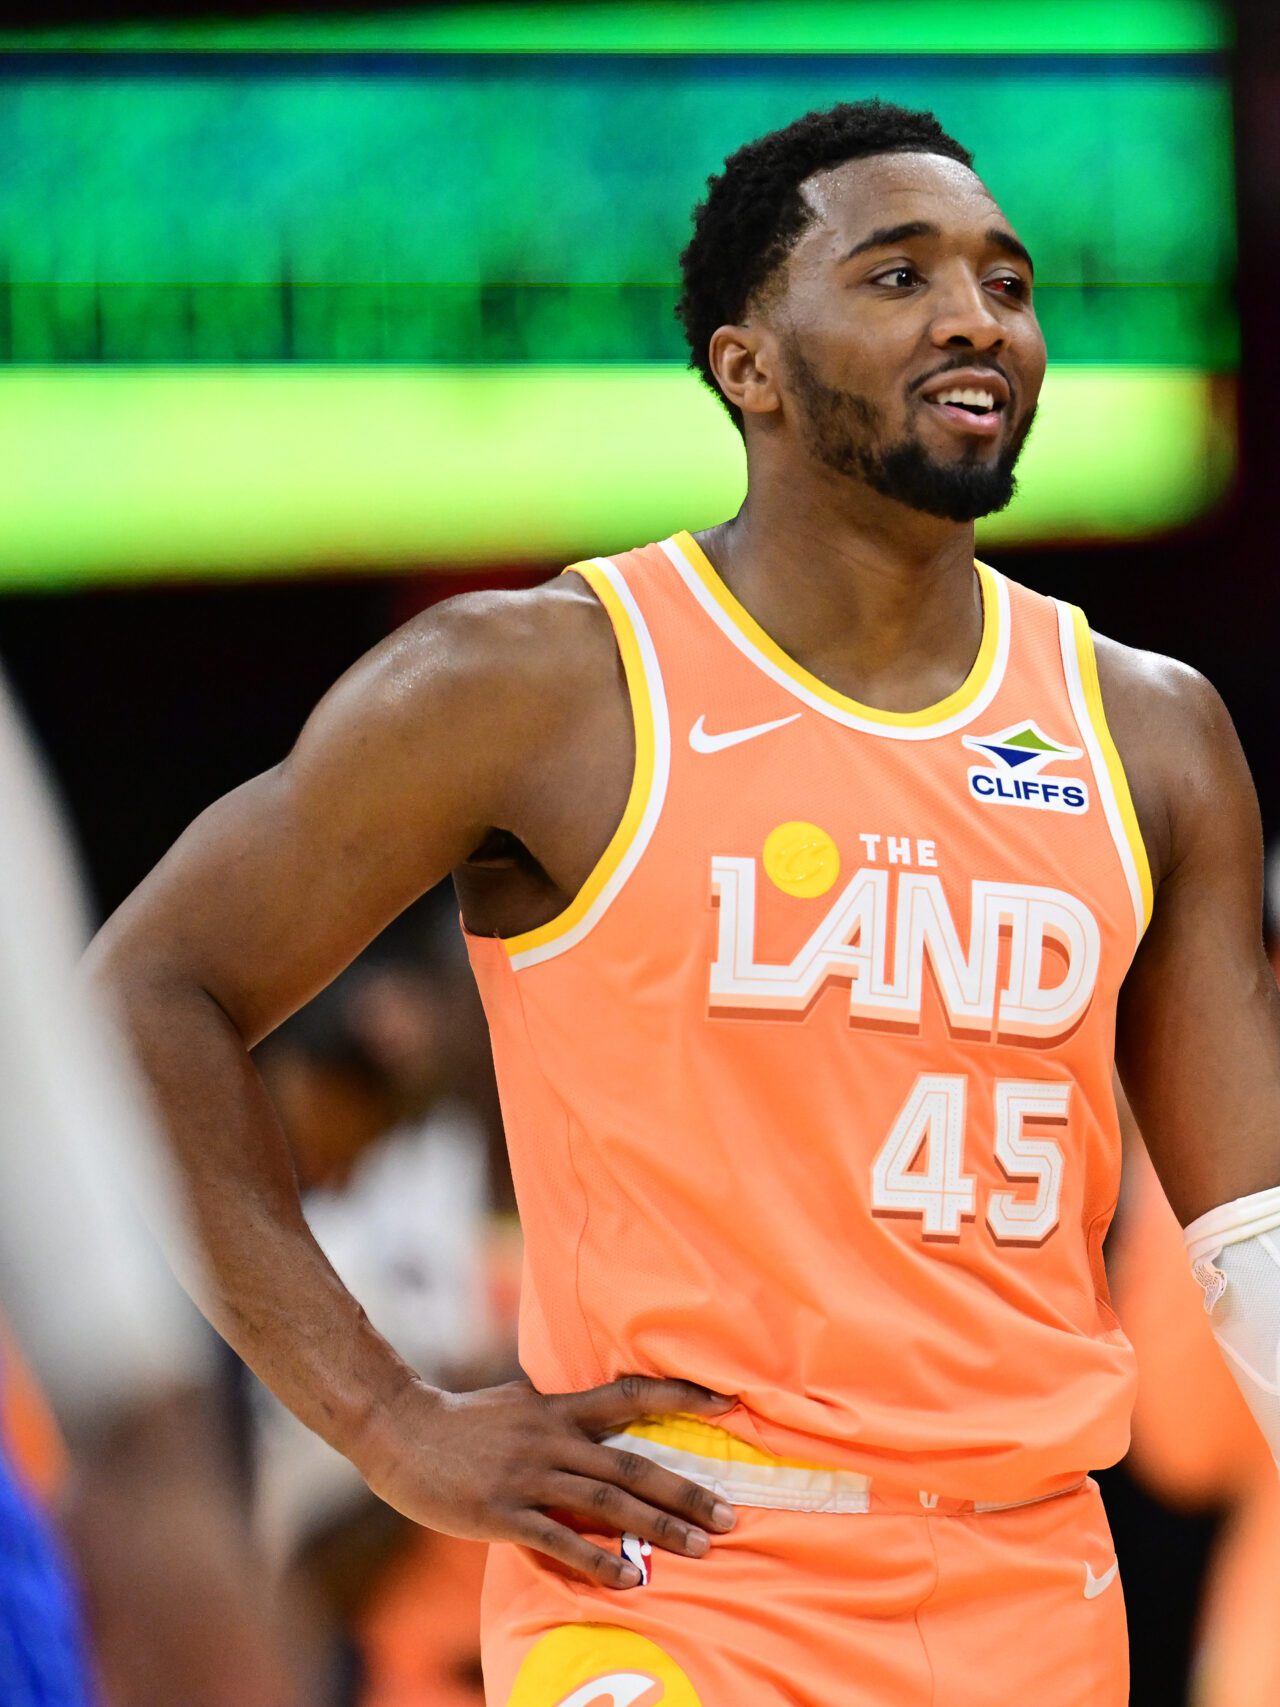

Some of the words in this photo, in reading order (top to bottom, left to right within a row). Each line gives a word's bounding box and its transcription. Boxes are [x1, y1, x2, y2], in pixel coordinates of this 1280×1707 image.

[972, 775, 1085, 807] CLIFFS
[859, 833, 938, 867] THE
[708, 856, 1101, 1047] LAND
[870, 1072, 1073, 1247] 45
